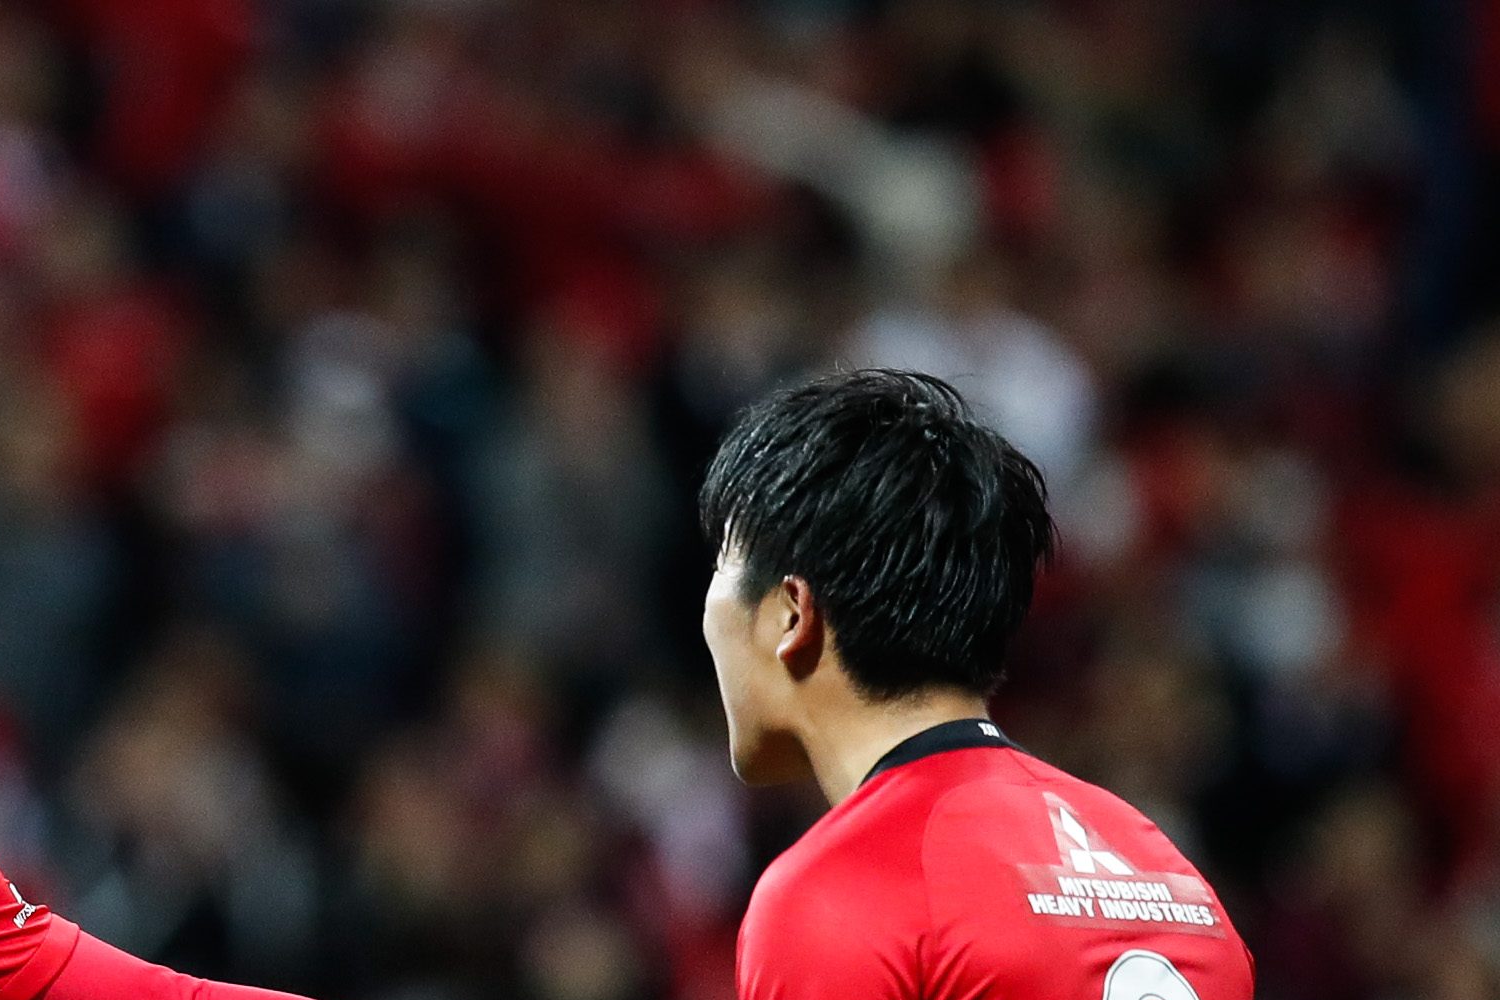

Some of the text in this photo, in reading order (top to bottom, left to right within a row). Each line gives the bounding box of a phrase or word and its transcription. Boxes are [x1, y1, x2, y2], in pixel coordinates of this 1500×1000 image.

[1057, 876, 1174, 902] MITSUBISHI
[1026, 893, 1216, 926] HEAVY INDUSTRIES
